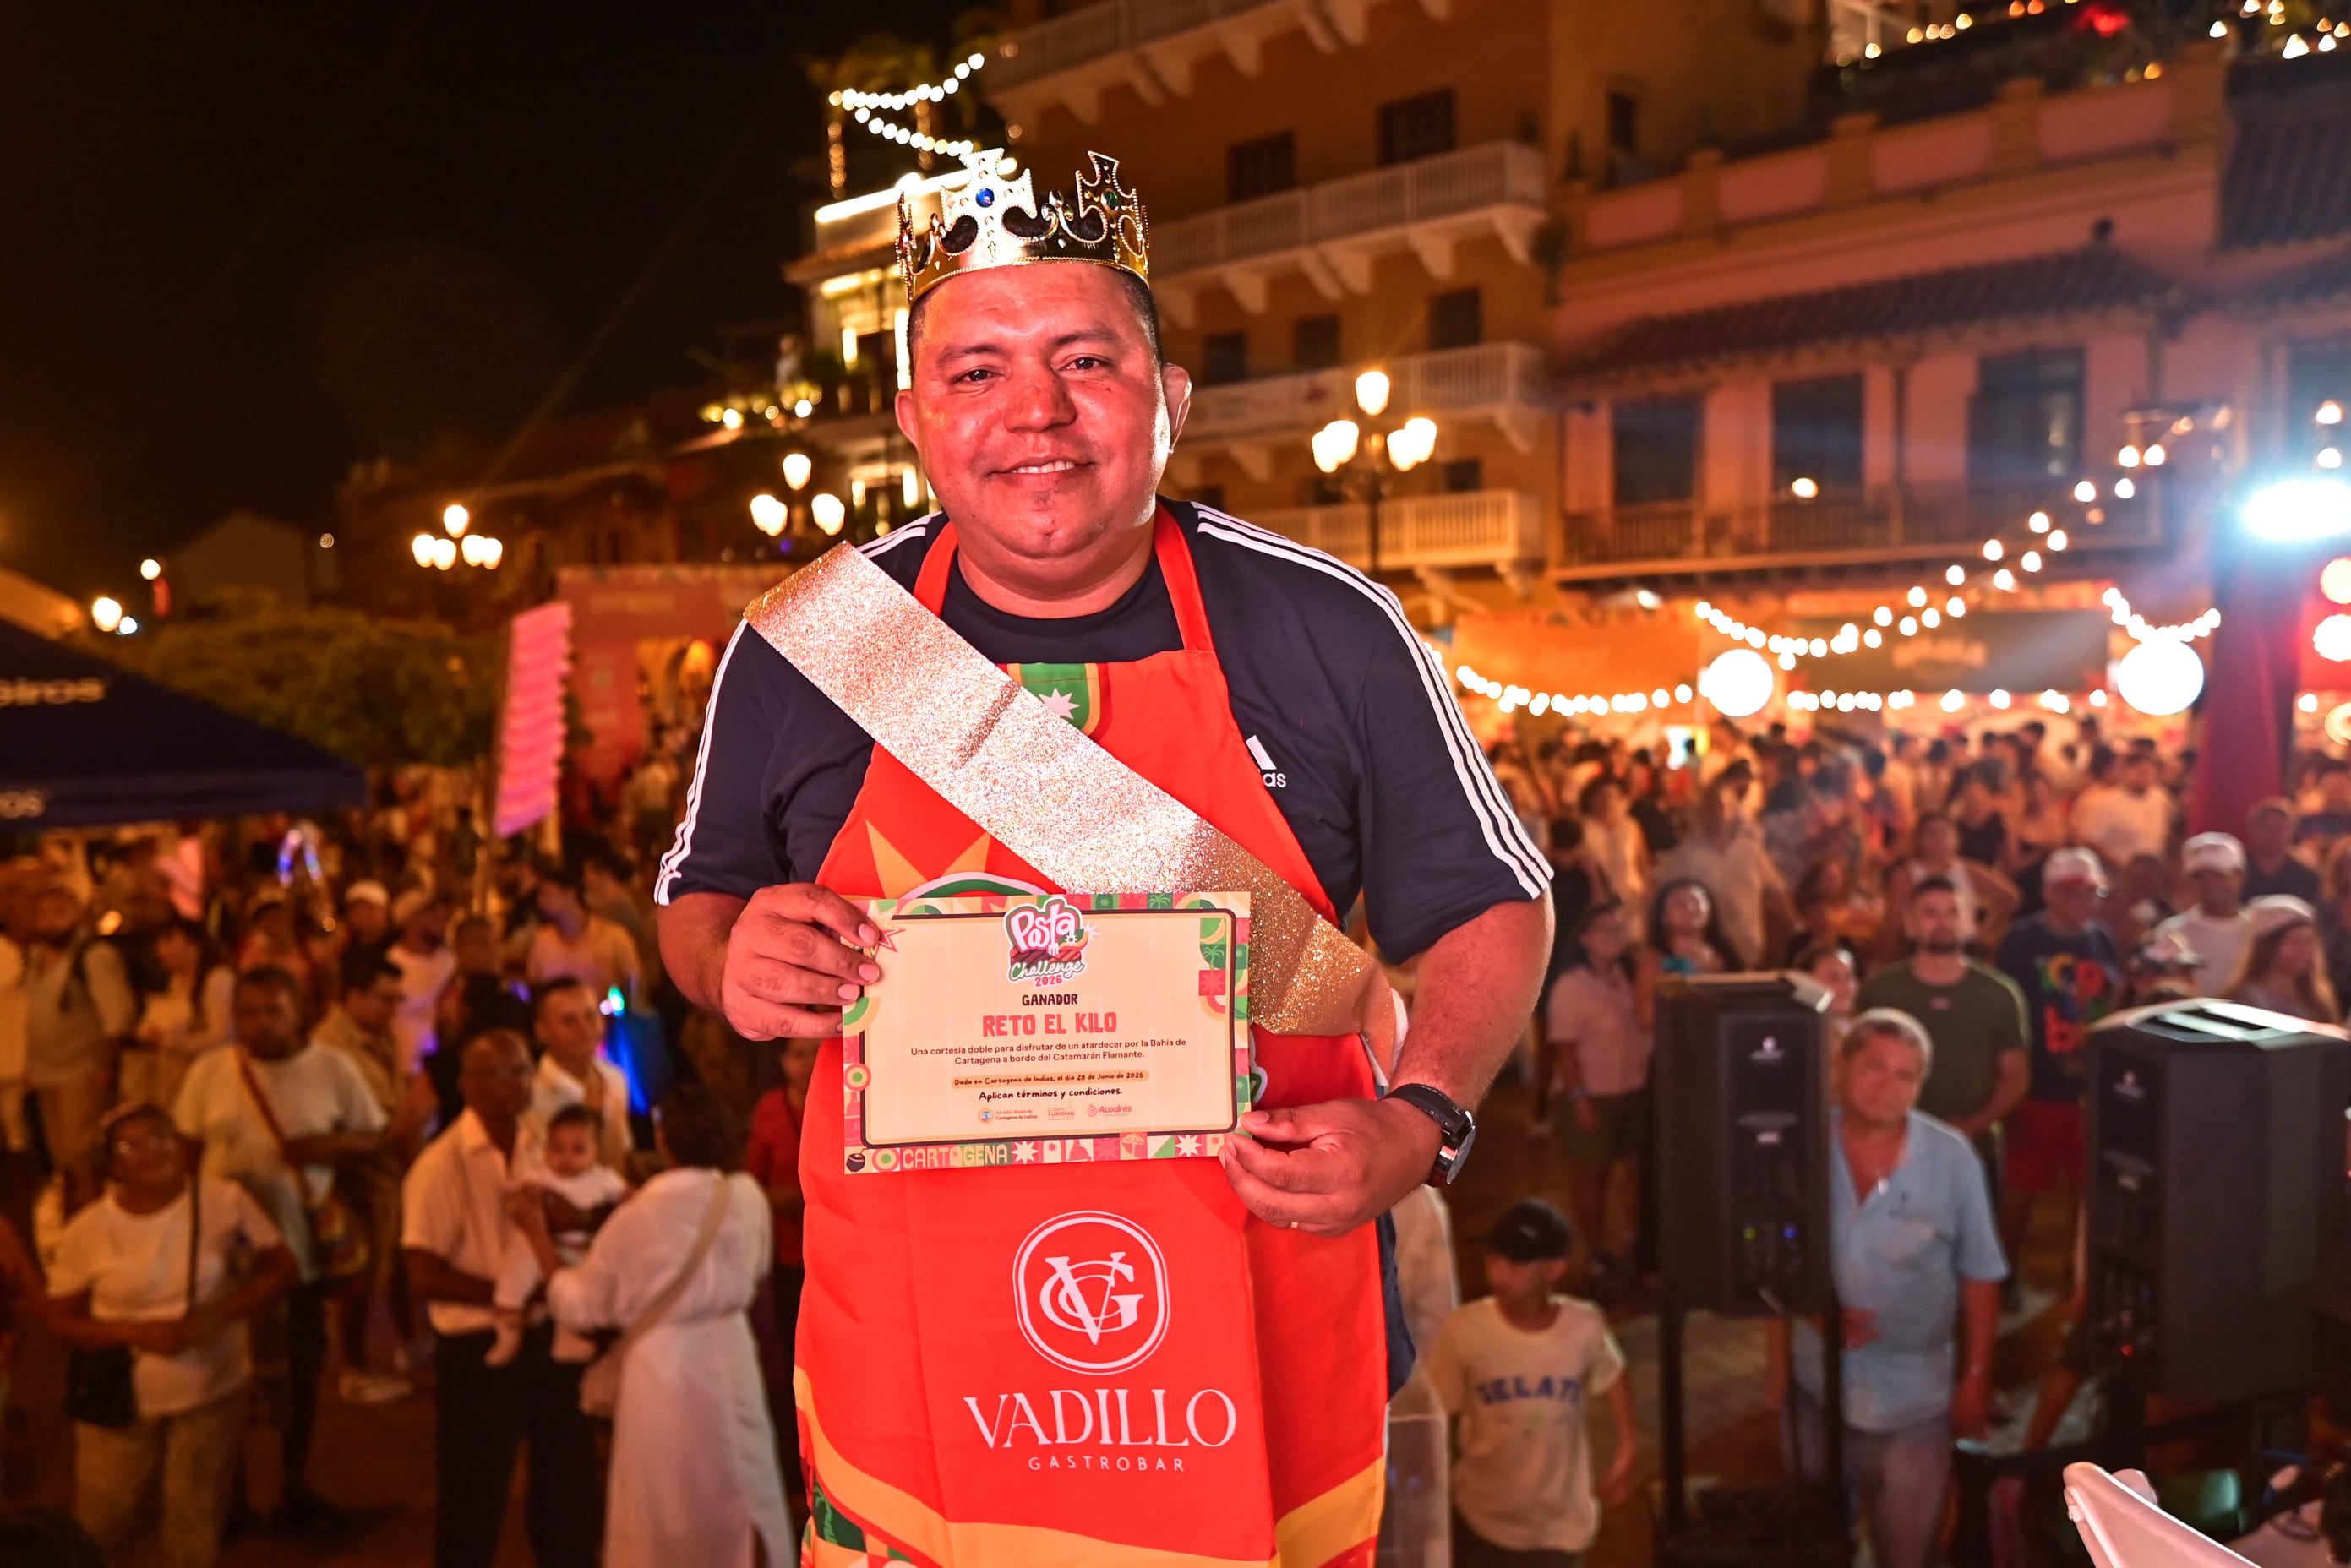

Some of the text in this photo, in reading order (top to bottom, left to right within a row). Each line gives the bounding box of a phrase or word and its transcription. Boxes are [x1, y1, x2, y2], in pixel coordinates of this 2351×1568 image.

[1011, 960, 1084, 981] Challenge
[1035, 974, 1062, 987] 2026
[1022, 993, 1078, 1006] GANADOR
[982, 1011, 1117, 1037] RETO EL KILO
[911, 1048, 929, 1056] Una
[930, 1046, 966, 1055] cortesía
[968, 1045, 993, 1054] doble
[995, 1046, 1015, 1054] para
[1016, 1043, 1053, 1053] disfrutar
[1055, 1042, 1066, 1051] de
[1081, 1040, 1122, 1049] atardecer
[1125, 1041, 1138, 1051] por
[1141, 1039, 1148, 1048] la
[1150, 1038, 1174, 1048] Bahía
[1176, 1038, 1186, 1047] de
[954, 1056, 1001, 1066] Cartagena
[1009, 1054, 1036, 1064] bordo
[1038, 1053, 1051, 1062] del
[1053, 1051, 1101, 1061] Catamarán
[1102, 1050, 1144, 1059] Flamante.
[954, 1078, 973, 1086] Dada
[984, 1076, 1022, 1086] Cartagena
[979, 1086, 1123, 1102] Aplican términos y condiciones.
[903, 1143, 1008, 1169] CARTAGENA
[962, 1388, 1237, 1449] VADILLO
[1028, 1455, 1185, 1473] GASTROBAR
